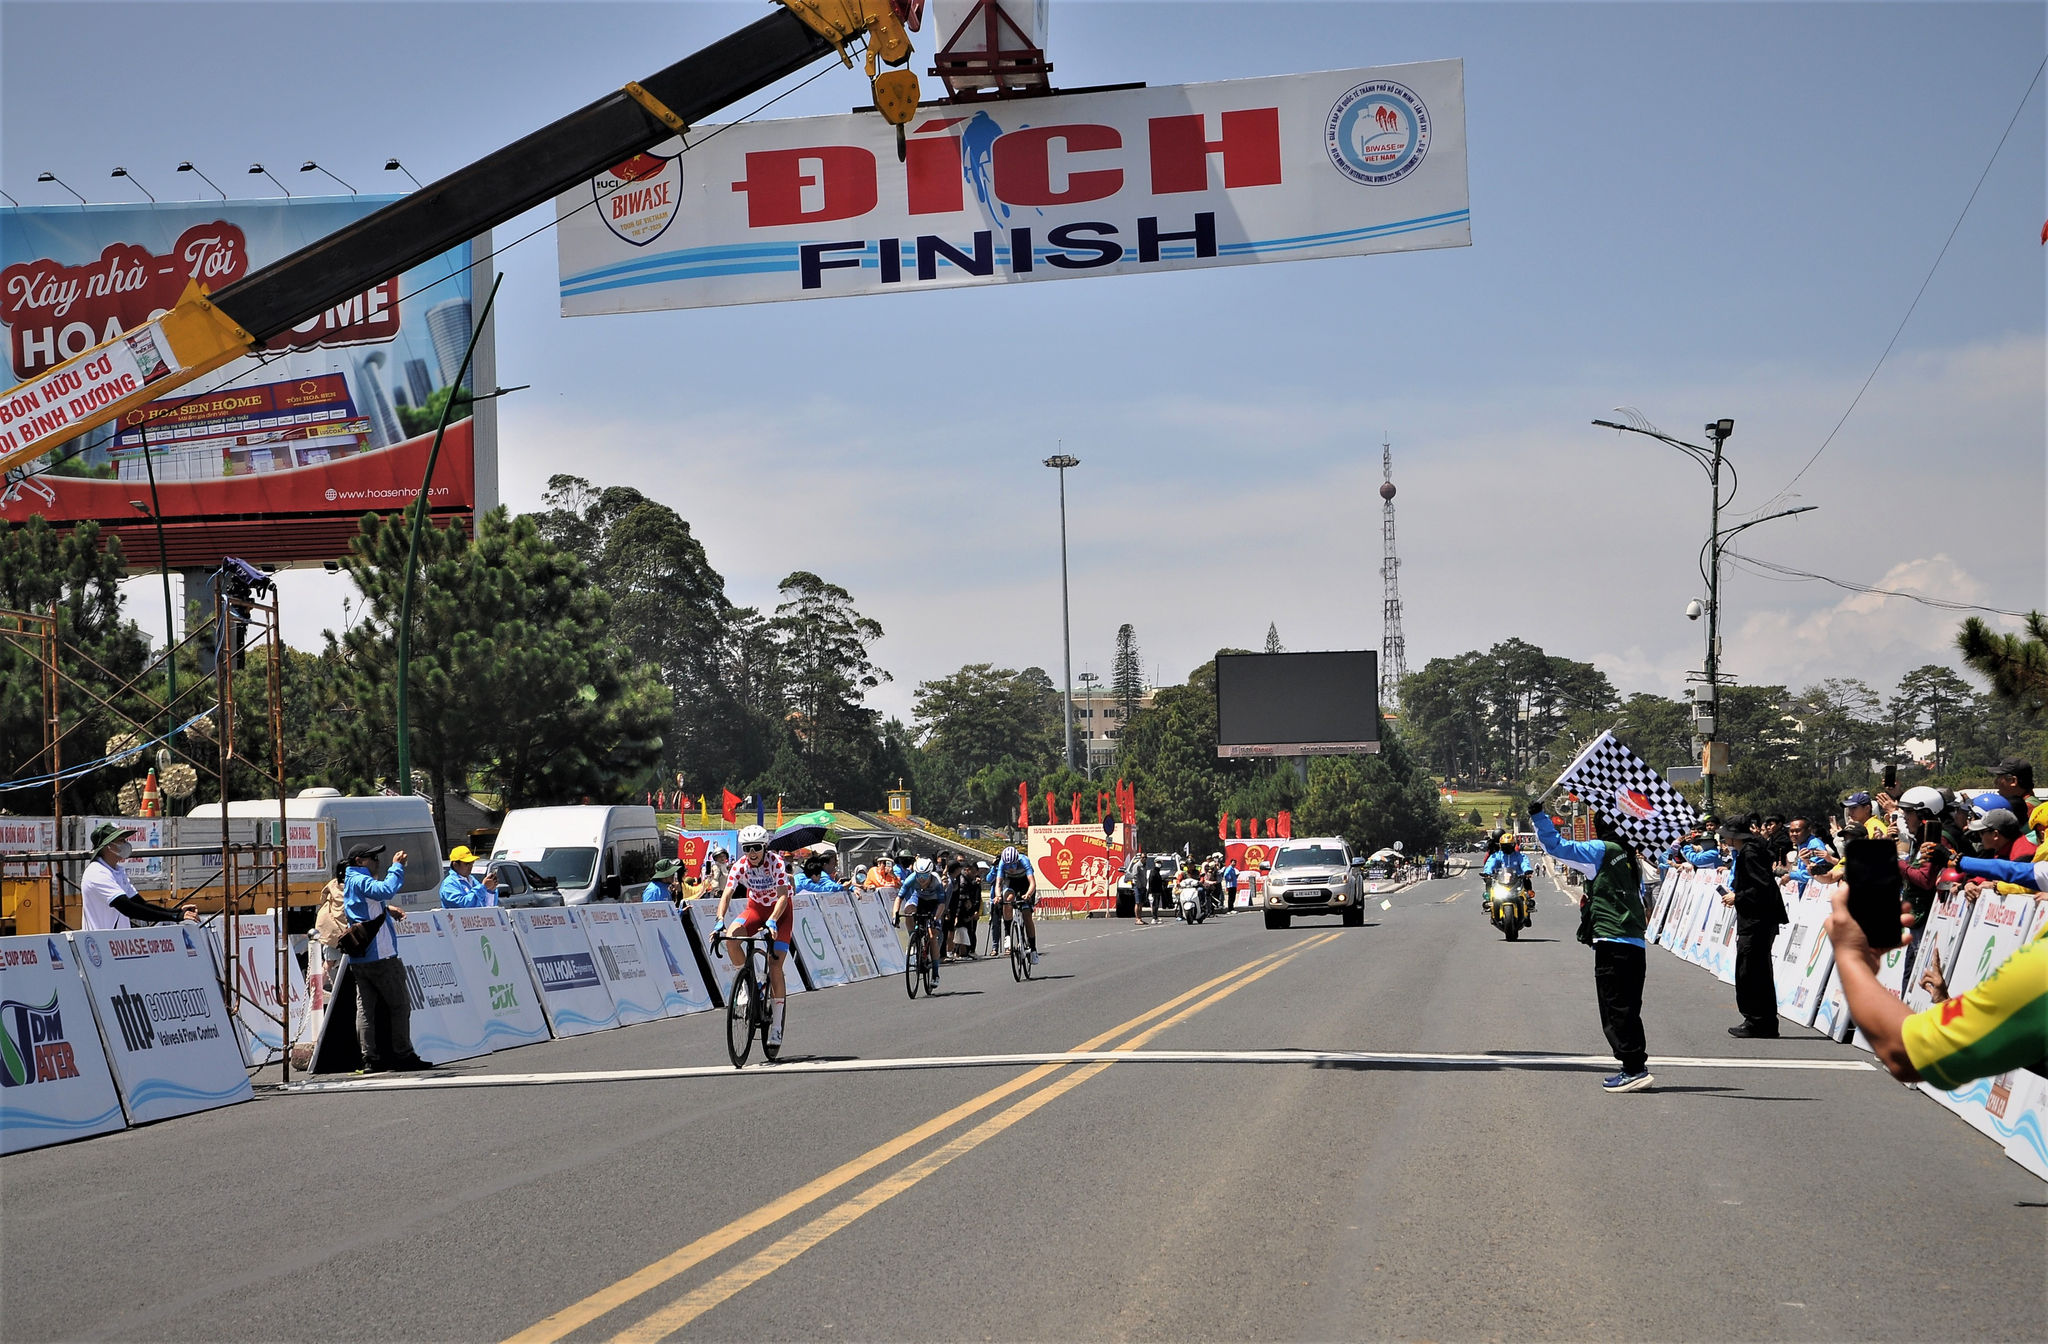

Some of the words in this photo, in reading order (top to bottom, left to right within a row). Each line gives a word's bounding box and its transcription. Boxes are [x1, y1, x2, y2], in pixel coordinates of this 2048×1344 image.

[1365, 154, 1379, 162] VIET
[1366, 143, 1396, 153] BIWASE
[731, 107, 1282, 228] ĐÍCH
[601, 180, 619, 188] UCI
[611, 181, 672, 220] BIWASE
[800, 211, 1217, 290] FINISH
[7, 272, 81, 317] Xây
[86, 256, 148, 299] nhà
[184, 235, 237, 278] Tới
[0, 391, 41, 425] BÓN
[41, 370, 82, 403] HỮU
[84, 352, 112, 381] CƠ
[303, 393, 320, 401] HOA
[18, 406, 68, 443] BÌNH
[68, 373, 136, 418] DƯƠNG
[149, 407, 178, 420] HOA
[180, 403, 209, 414] SEN
[212, 395, 262, 411] HOME
[5, 950, 20, 966] CUP
[20, 949, 38, 965] 2026
[109, 938, 149, 957] BIWASE
[148, 940, 160, 954] CUP
[536, 962, 556, 981] TAN
[553, 960, 575, 980] HOA
[110, 984, 155, 1052] ntp
[145, 987, 211, 1022] company
[157, 1030, 179, 1046] Valves
[197, 1024, 220, 1040] Control
